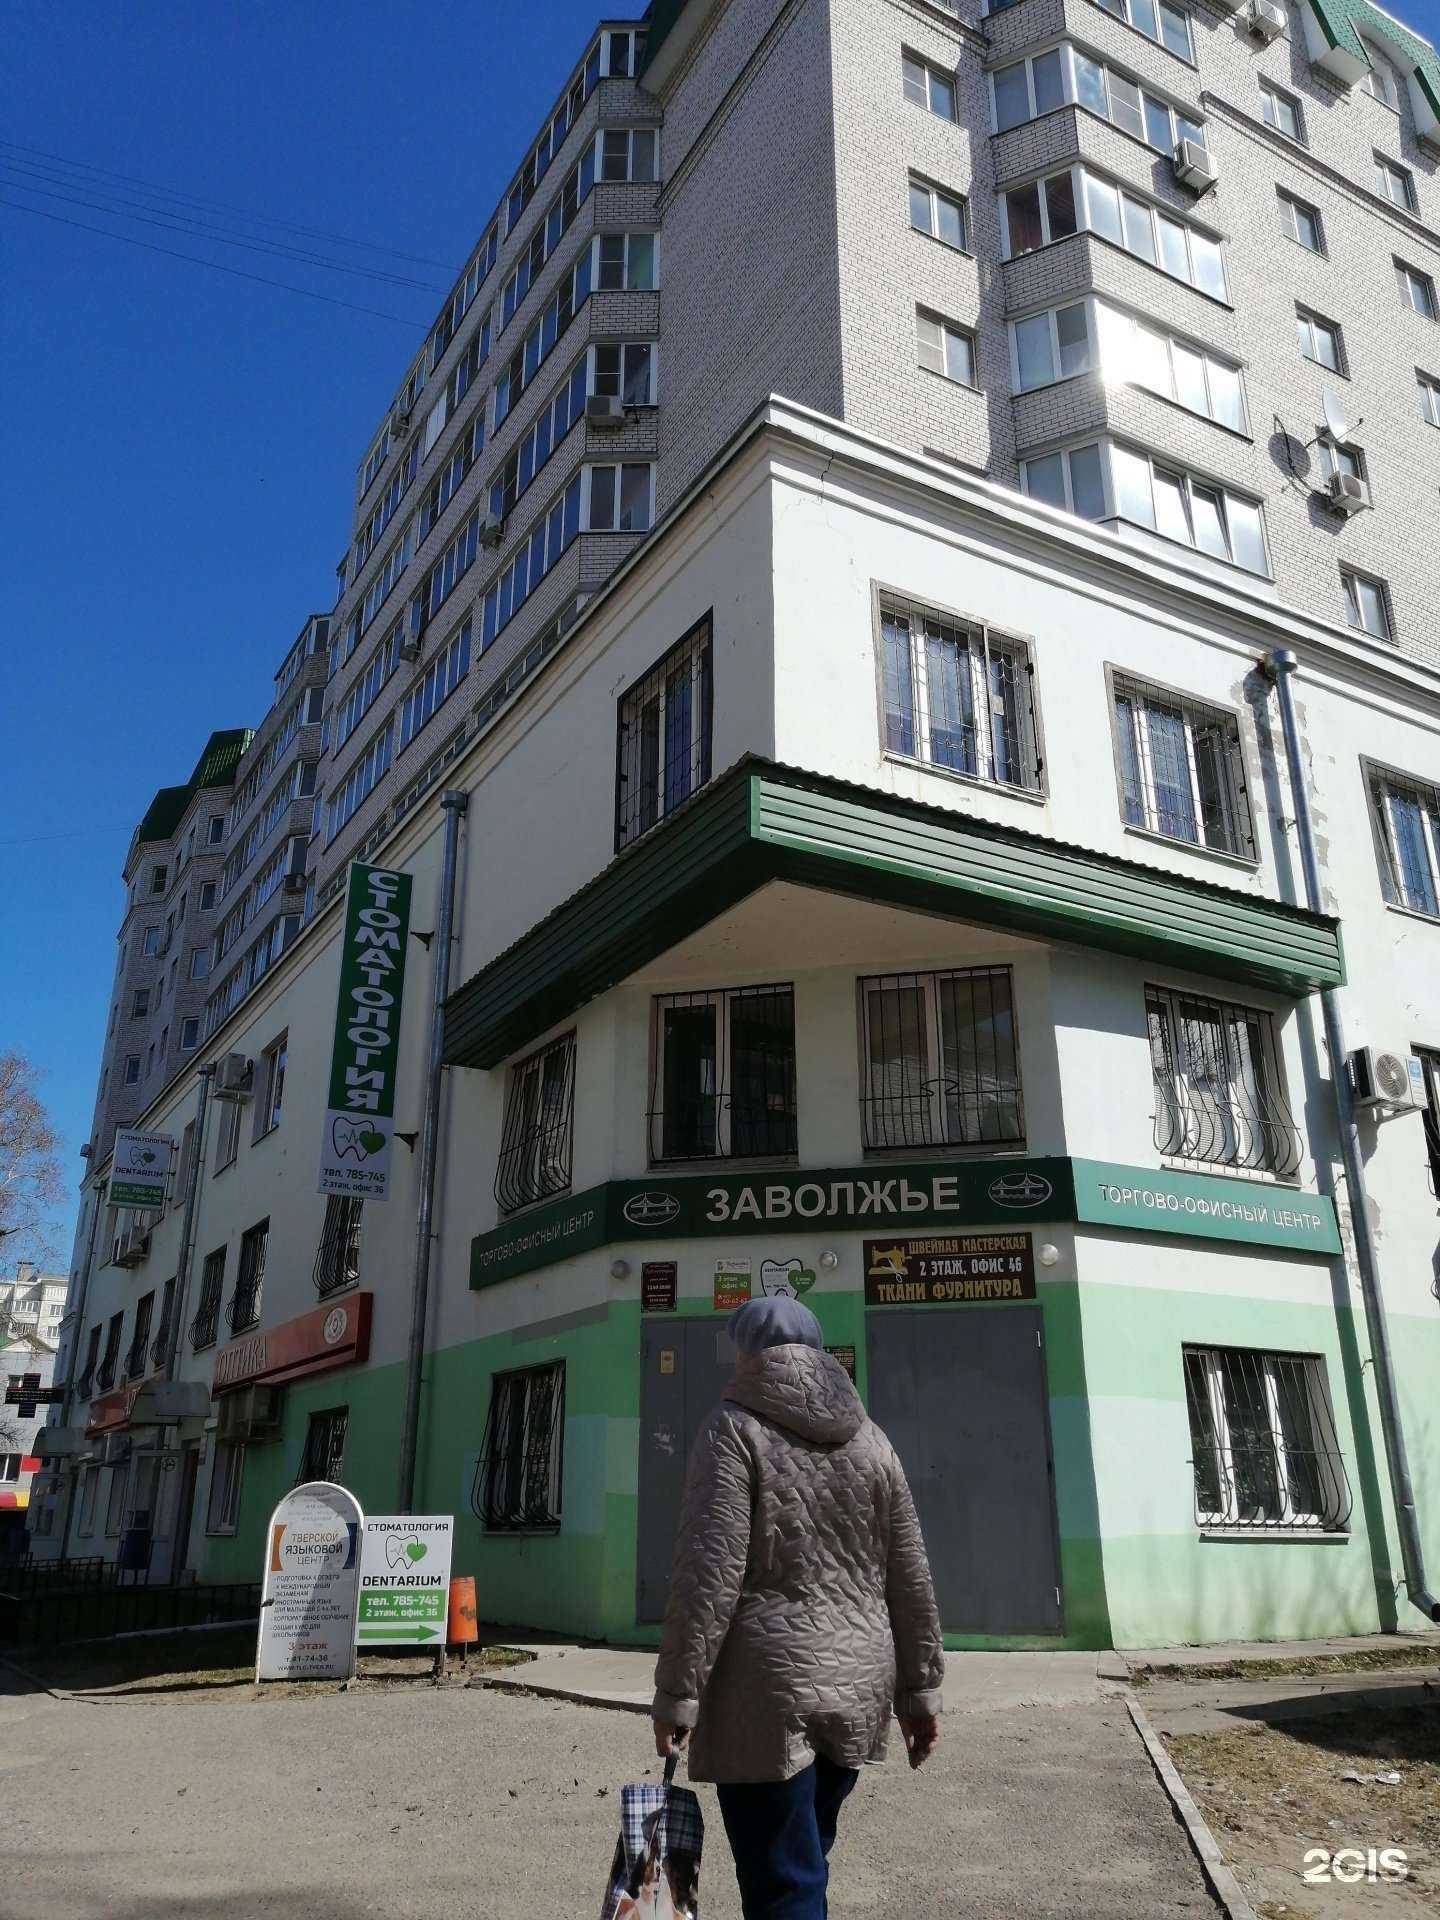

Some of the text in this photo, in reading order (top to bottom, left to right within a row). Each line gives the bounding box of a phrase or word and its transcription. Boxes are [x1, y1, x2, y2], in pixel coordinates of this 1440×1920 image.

[345, 870, 401, 1110] СТОМАТОЛОГИЯ
[346, 1169, 385, 1182] 785-745
[706, 1176, 960, 1222] ЗАВОЛЖЬЕ
[1098, 1184, 1321, 1232] ТОРГОВО-ОФИСНЫЙ ЦЕНТР
[479, 1210, 595, 1266] ТОРГОВО-ОФИСНЫЙ ЦЕНТР
[908, 1236, 1027, 1255] ШВЕЙНАЯ МАСТЕРСКАЯ
[919, 1261, 927, 1277] 2
[971, 1258, 1004, 1274] ОФИС
[1009, 1256, 1023, 1272] 46
[877, 1278, 1023, 1302] ТКАНИ ФУРНИТУРА
[217, 1335, 267, 1384] ОПТИКА
[367, 1523, 449, 1532] СТОМАТОЛОГИЯ
[291, 1532, 338, 1543] ТВЕРСКОЙ
[285, 1544, 343, 1555] ЯЗЫКОВОЙ
[297, 1556, 330, 1566] ЦЕНТР
[362, 1575, 442, 1586] DENTARIUM
[367, 1596, 439, 1606] тел. 785-745
[366, 1608, 372, 1617] 2
[401, 1608, 424, 1618] офис
